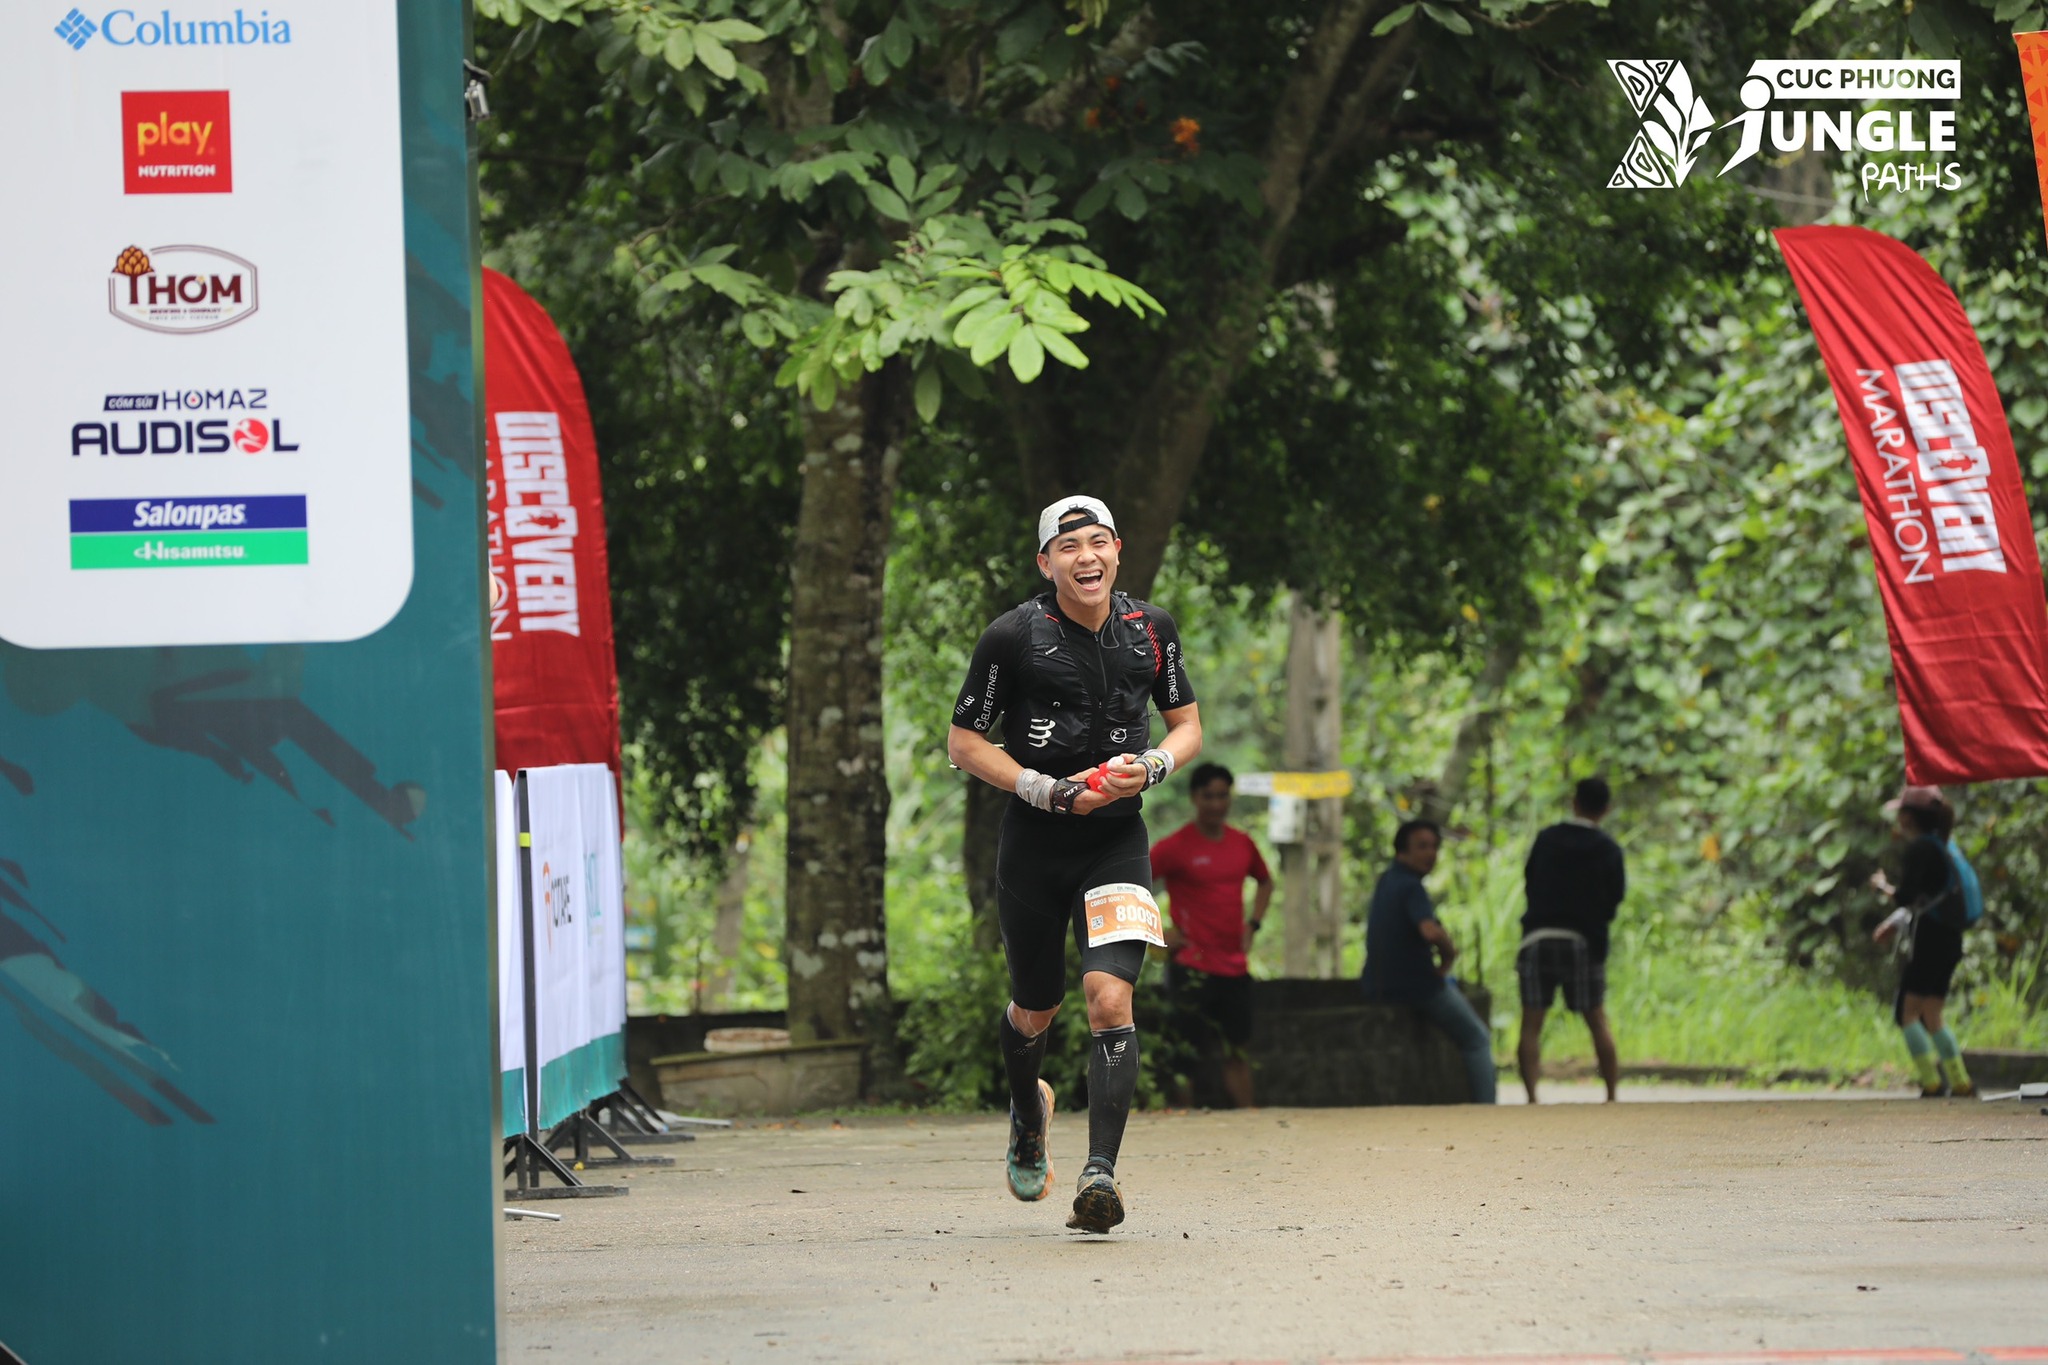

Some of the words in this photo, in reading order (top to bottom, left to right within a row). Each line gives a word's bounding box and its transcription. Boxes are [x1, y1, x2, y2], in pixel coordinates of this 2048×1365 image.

[101, 9, 292, 46] Columbia
[137, 111, 214, 156] play
[138, 164, 216, 178] NUTRITION
[162, 388, 268, 410] HOMAZ
[1856, 368, 1935, 584] MARATHON
[1893, 359, 2008, 574] DISCOVERY
[133, 501, 247, 530] Salonpas
[494, 411, 581, 637] DISCOVERY
[134, 541, 246, 560] Hisamitsu
[985, 663, 999, 700] FITNESS
[1168, 674, 1179, 704] FITNESS
[1115, 904, 1158, 930] 80097
